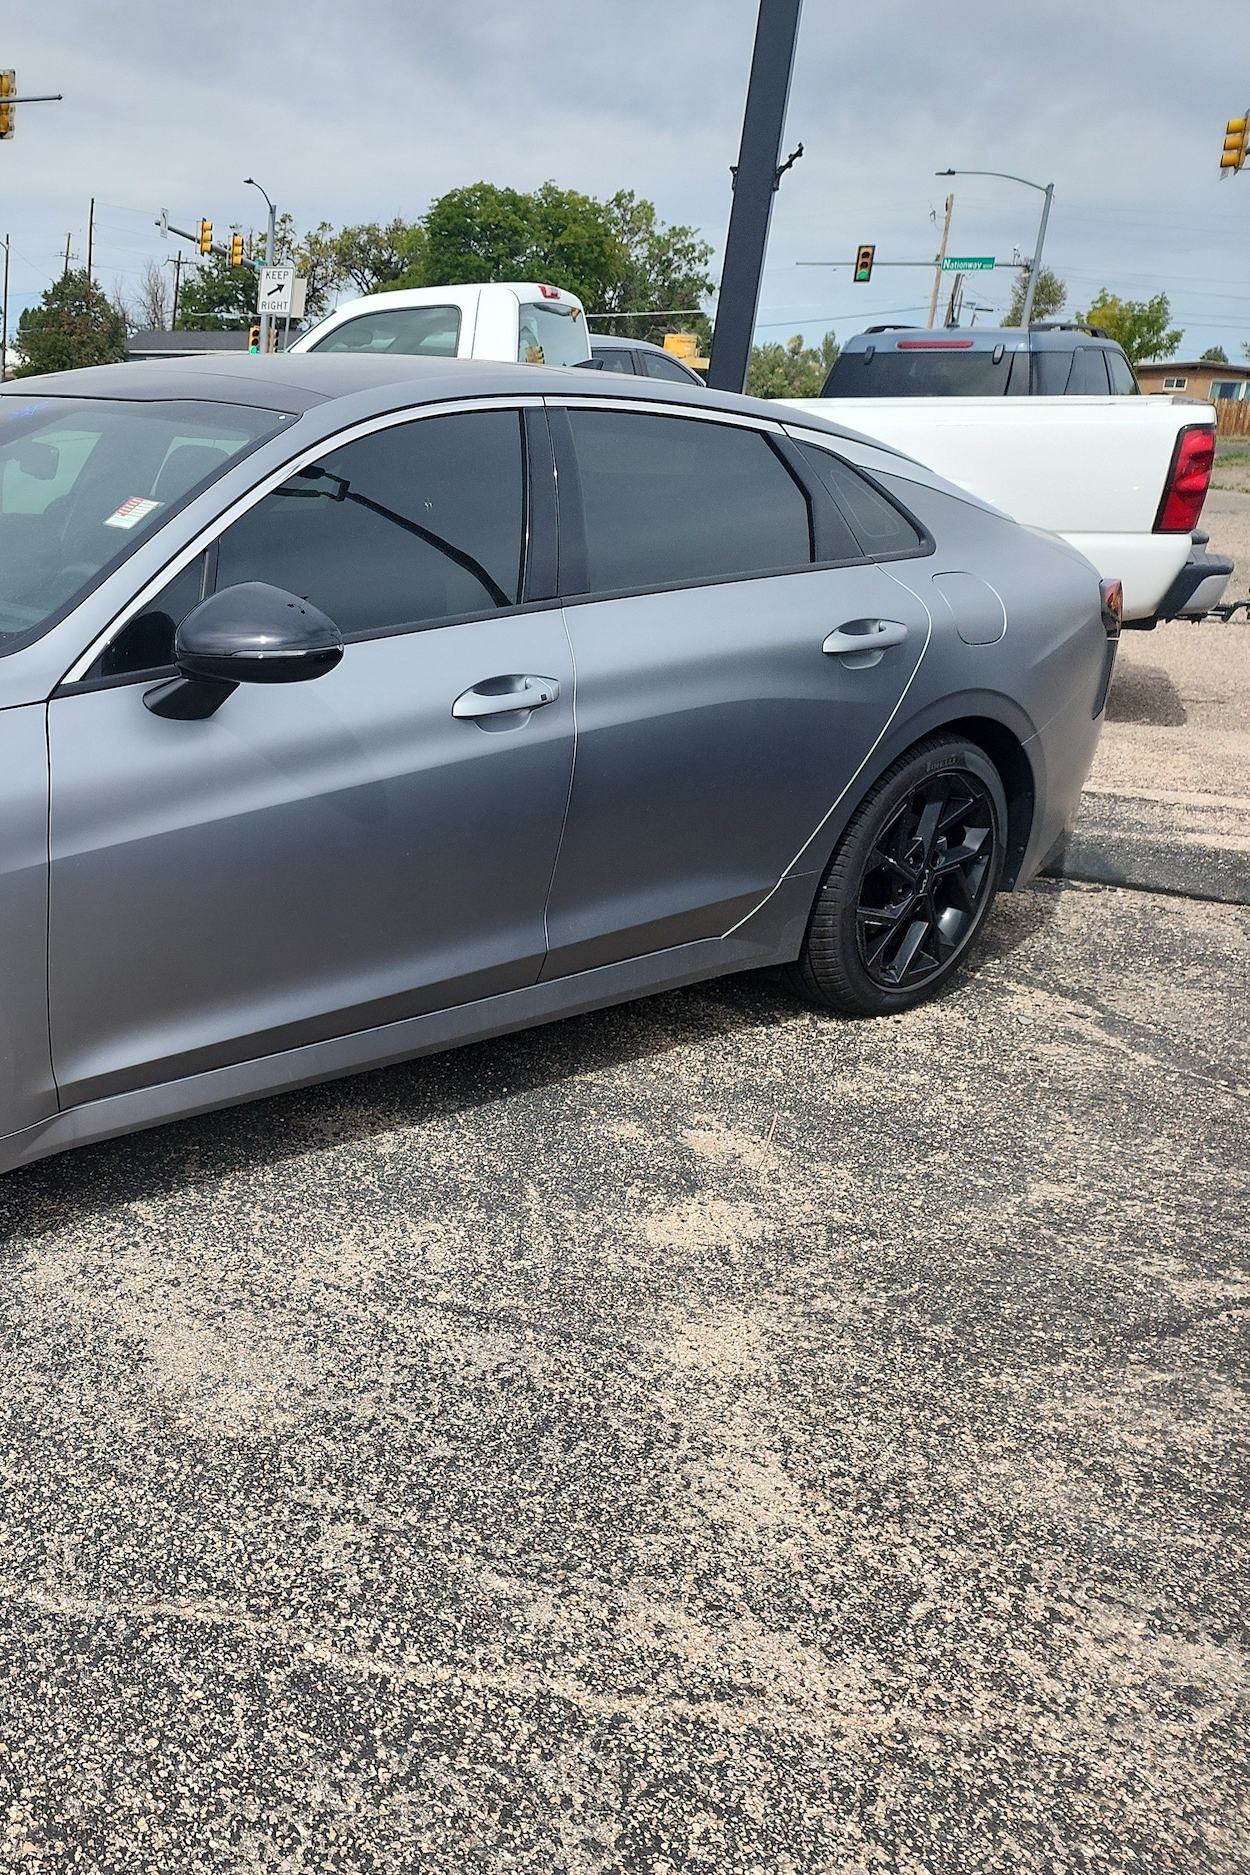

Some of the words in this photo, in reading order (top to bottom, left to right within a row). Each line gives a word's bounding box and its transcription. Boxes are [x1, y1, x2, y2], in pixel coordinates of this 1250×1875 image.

[943, 258, 982, 270] Nationway
[265, 270, 289, 280] KEEP
[261, 300, 288, 311] RIGHT
